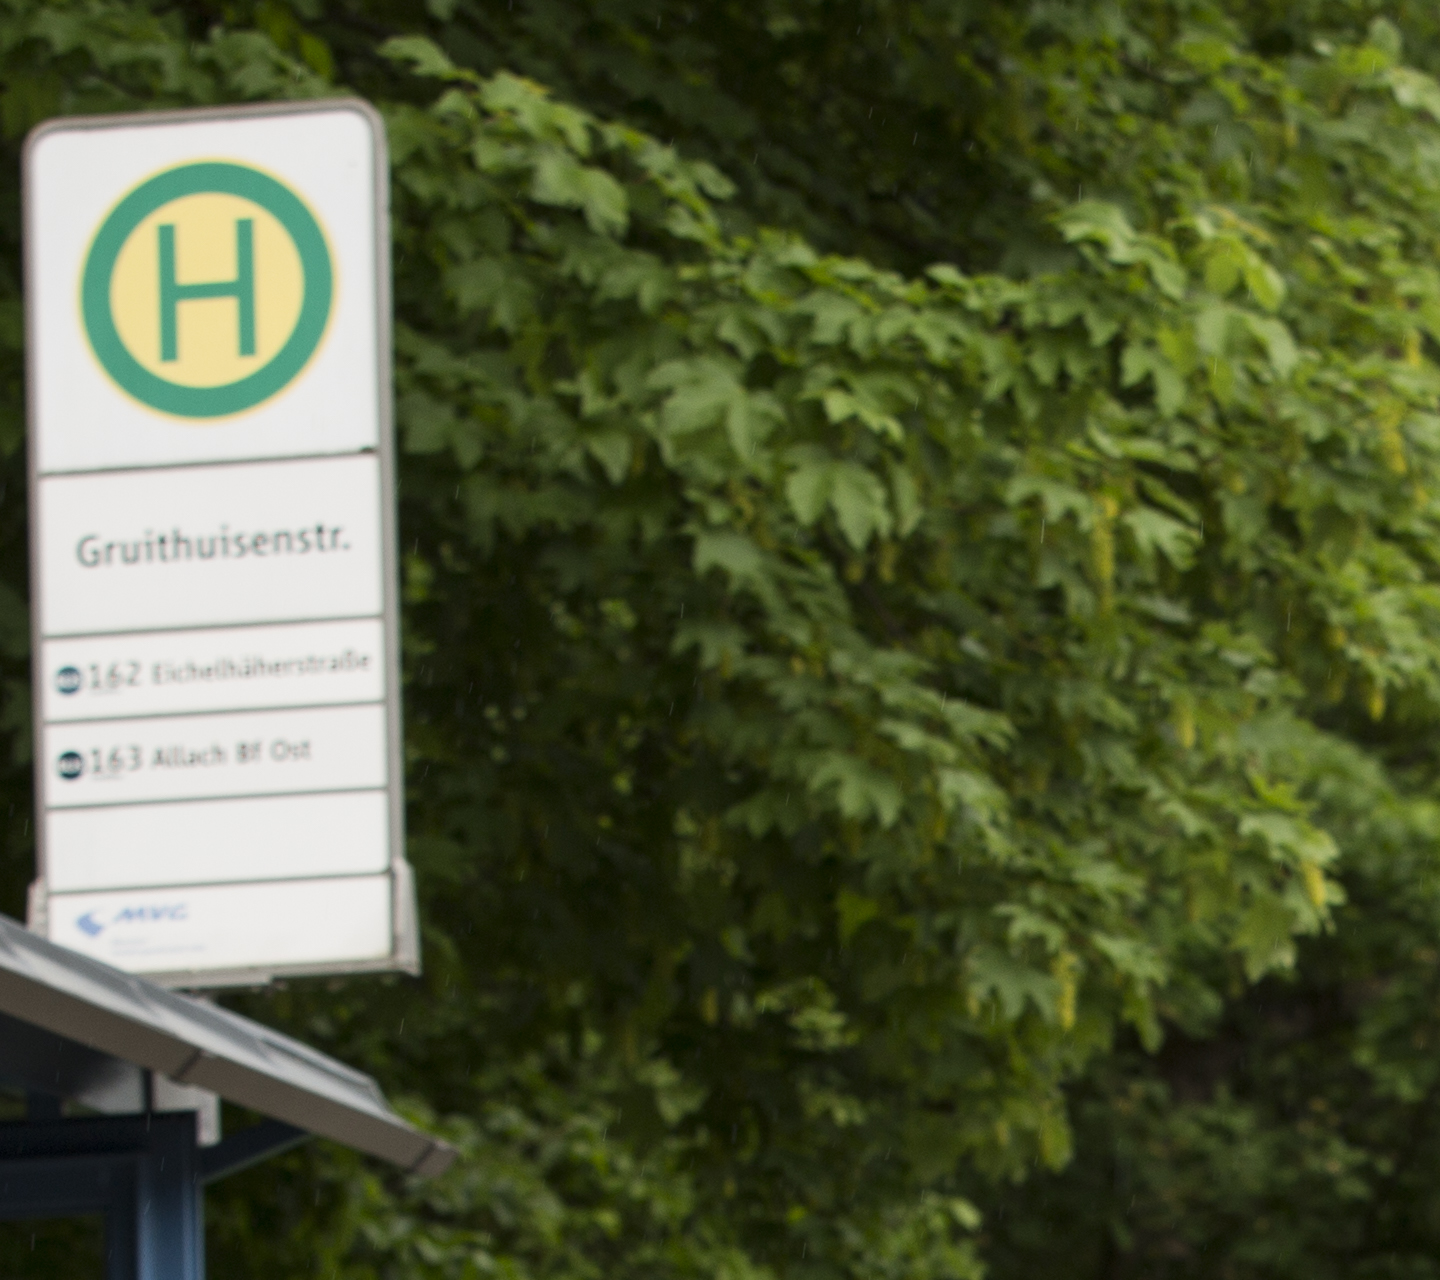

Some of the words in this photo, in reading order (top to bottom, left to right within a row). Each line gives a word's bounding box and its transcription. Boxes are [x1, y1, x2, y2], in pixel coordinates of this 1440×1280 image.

[157, 218, 256, 362] H
[76, 524, 350, 568] Gruithuisenstr.
[89, 661, 141, 688] 162
[90, 744, 142, 770] 163
[151, 745, 227, 768] Allach
[236, 741, 262, 764] Bf
[270, 739, 311, 761] Ost
